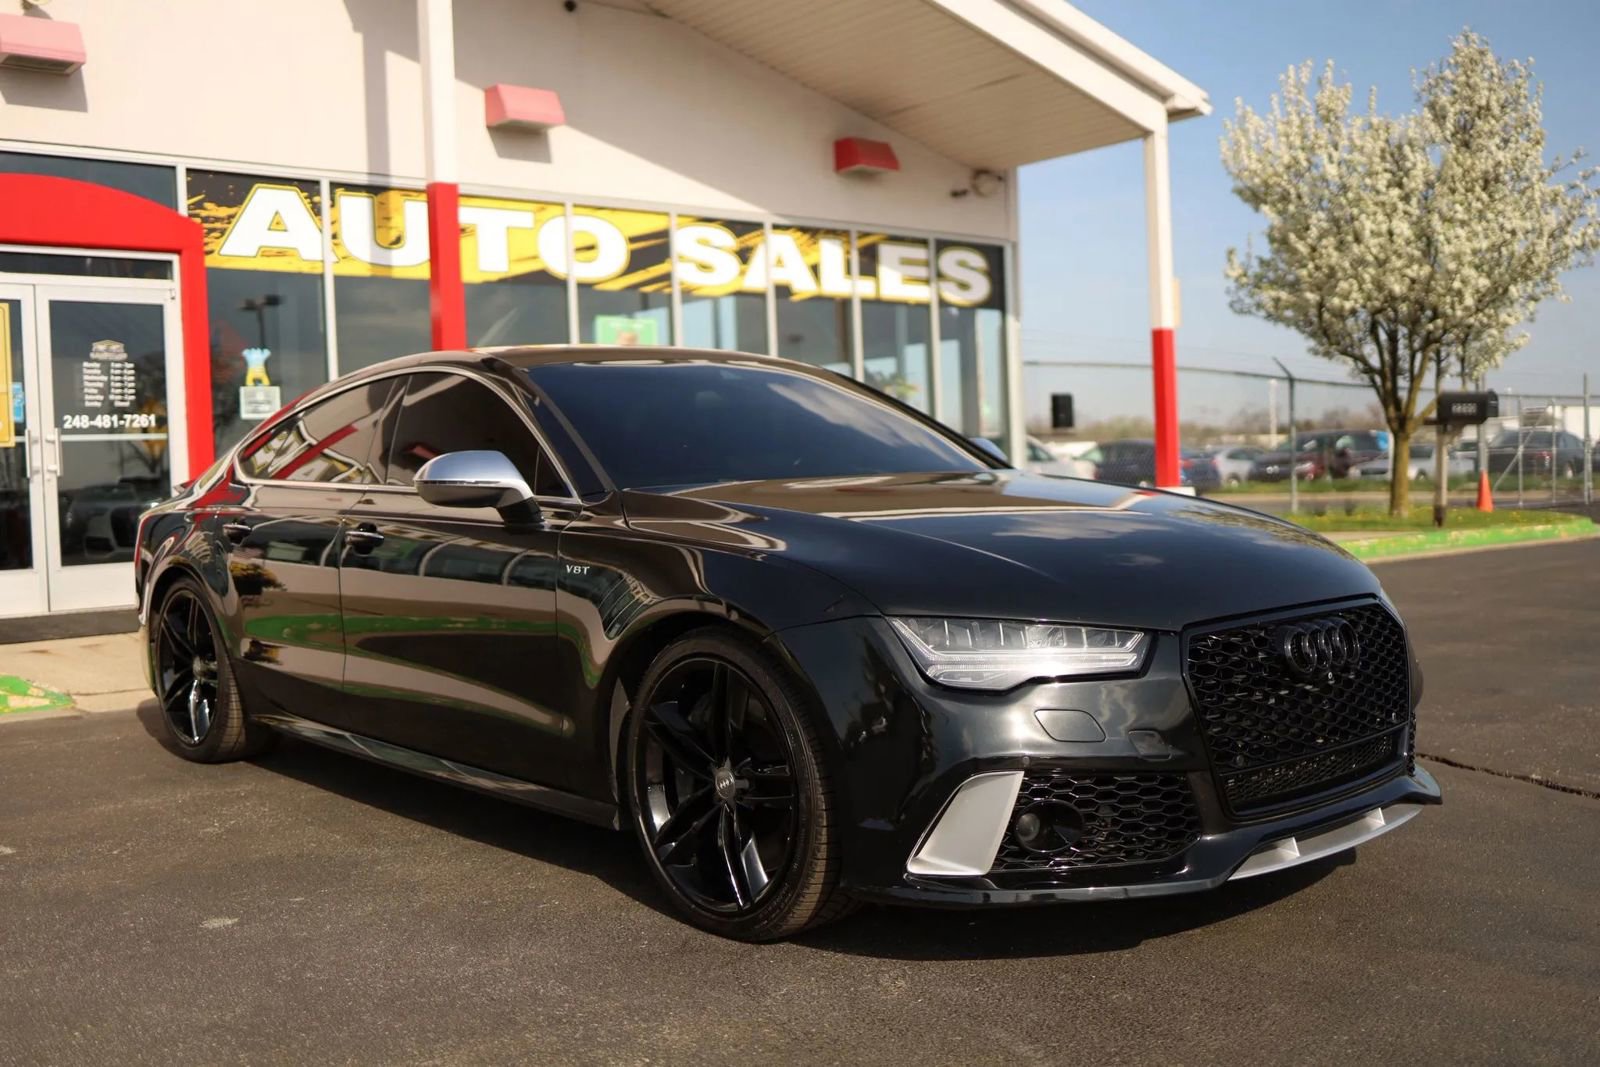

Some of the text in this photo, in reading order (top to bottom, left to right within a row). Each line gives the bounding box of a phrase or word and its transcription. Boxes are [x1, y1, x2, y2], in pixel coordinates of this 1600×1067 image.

[218, 184, 992, 307] AUTO SALES
[63, 414, 156, 429] 248-481-7261
[566, 564, 590, 575] V8T
